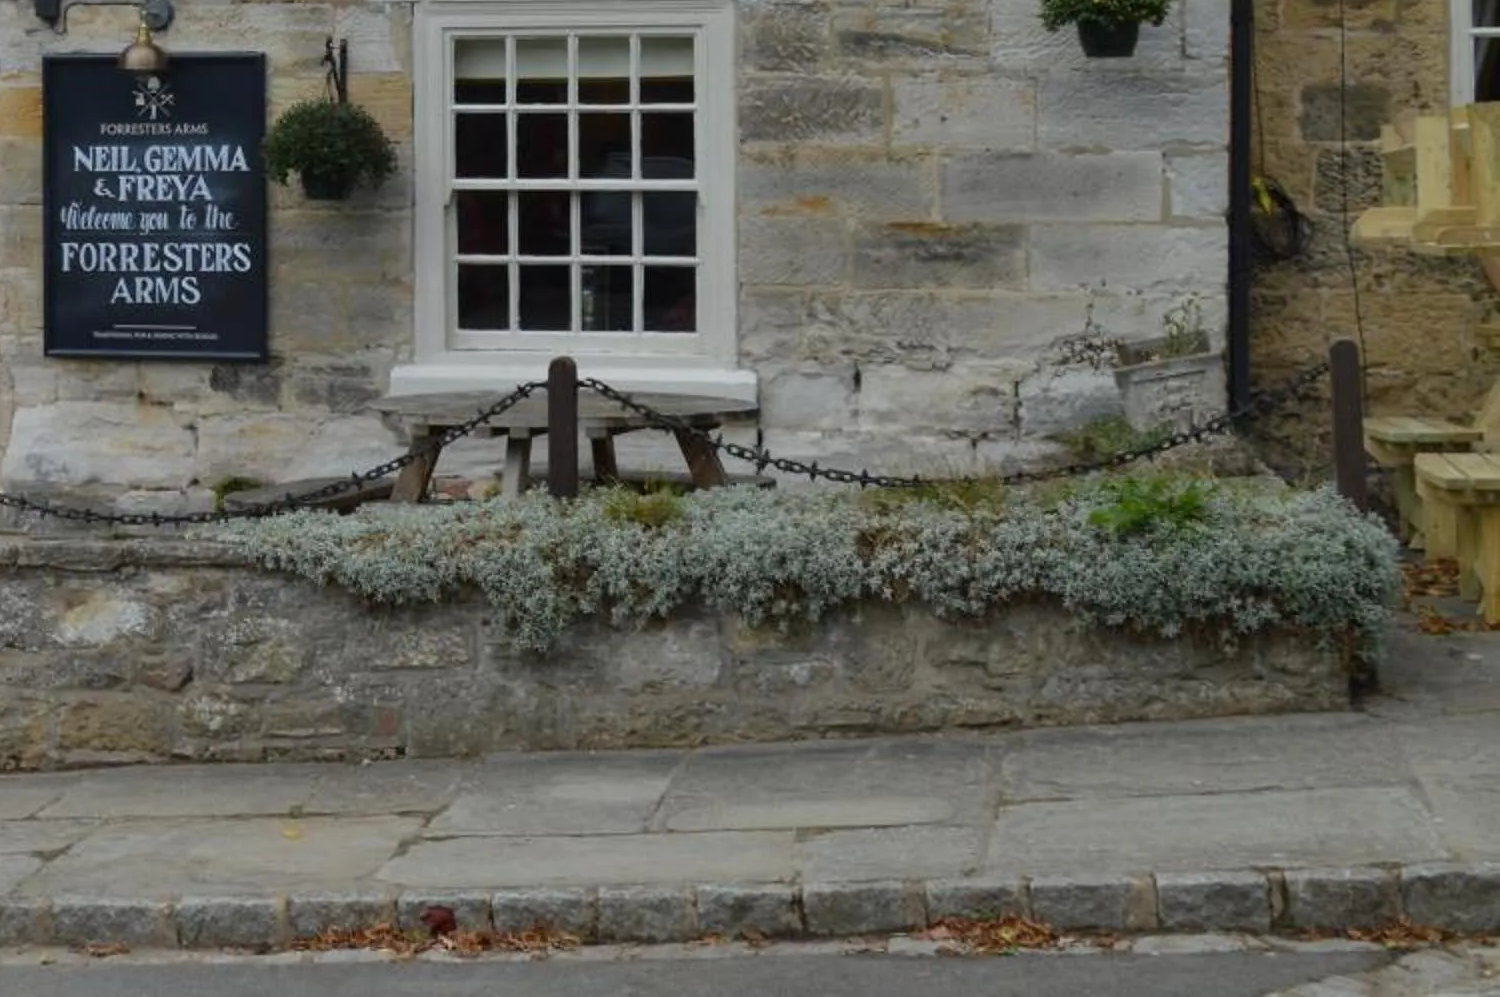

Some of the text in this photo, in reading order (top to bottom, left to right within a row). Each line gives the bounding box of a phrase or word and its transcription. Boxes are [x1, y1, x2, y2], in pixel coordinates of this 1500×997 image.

[100, 122, 209, 136] FORRESTERS ARMS
[143, 144, 249, 173] GEMMA
[93, 174, 213, 202] & FREYA
[139, 212, 169, 236] you
[179, 204, 197, 230] to
[61, 242, 251, 272] FORRESTERS
[110, 276, 201, 305] ARMS
